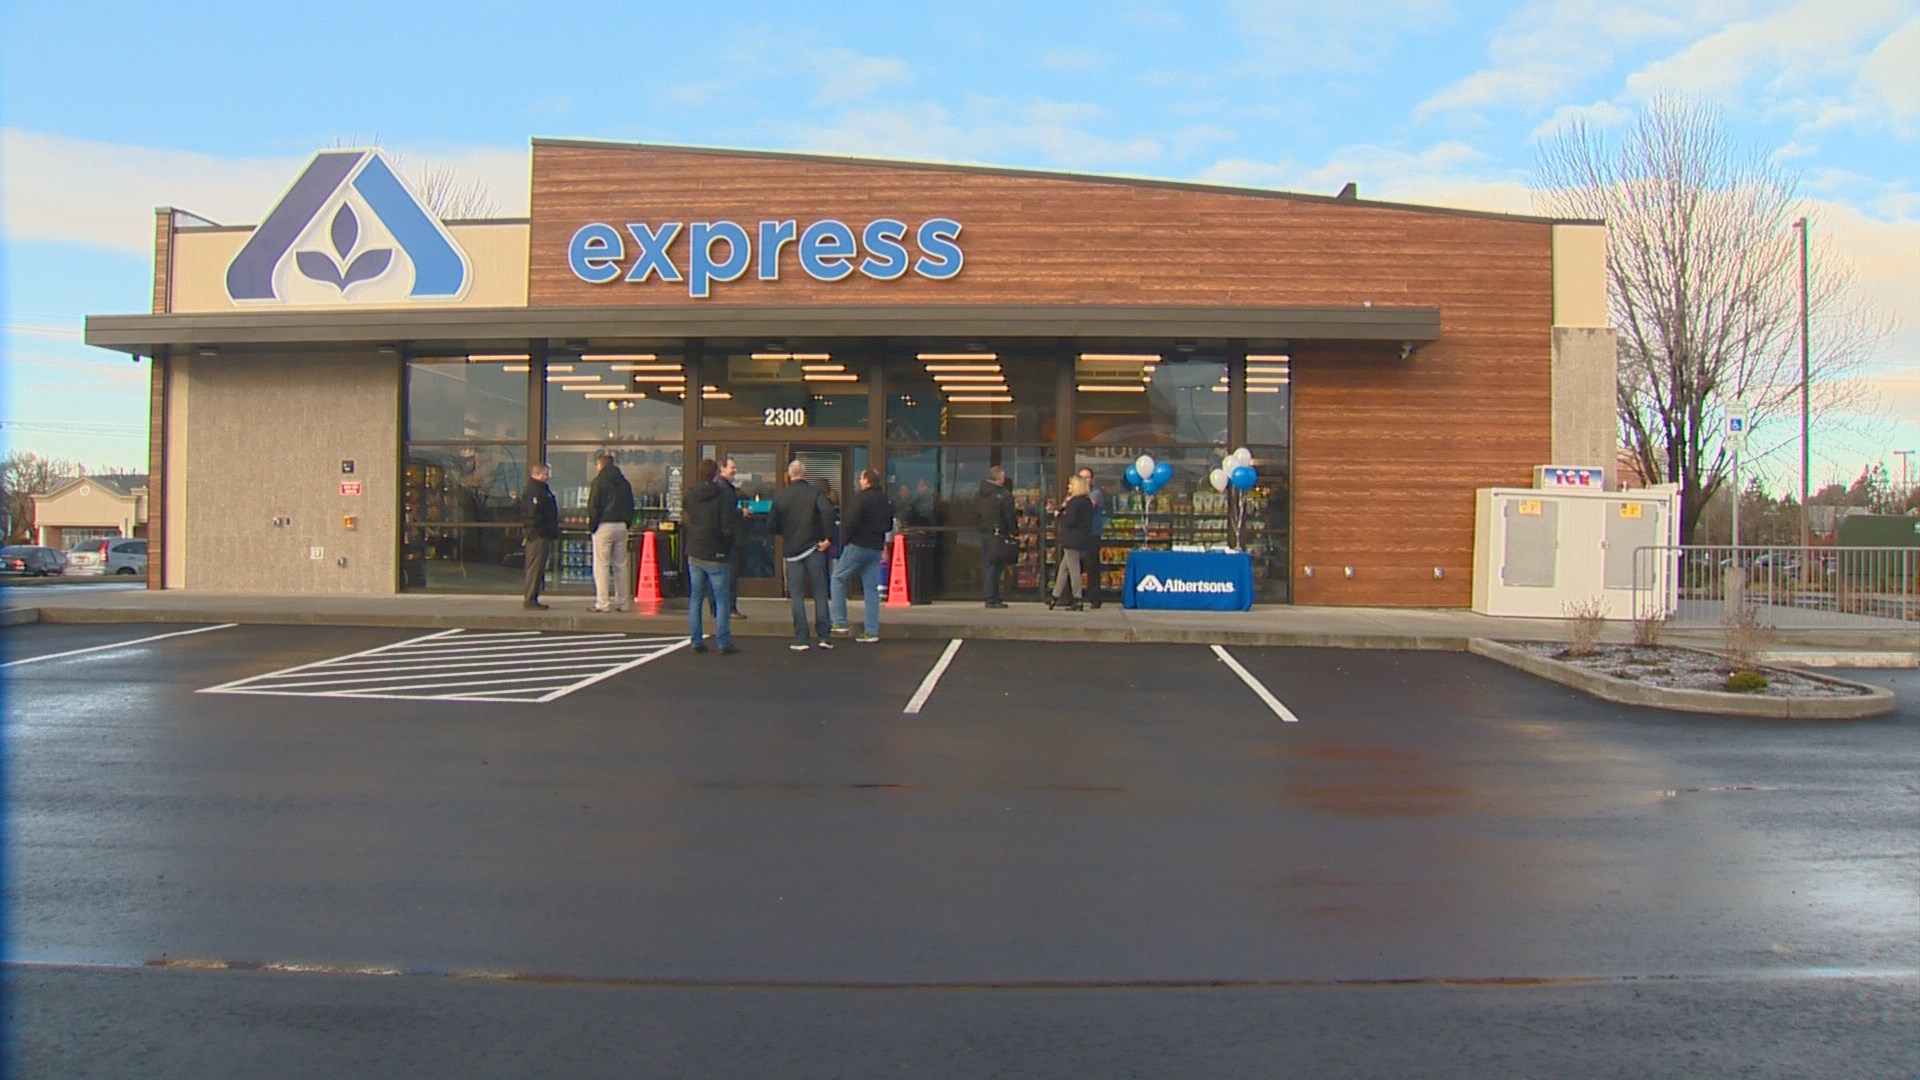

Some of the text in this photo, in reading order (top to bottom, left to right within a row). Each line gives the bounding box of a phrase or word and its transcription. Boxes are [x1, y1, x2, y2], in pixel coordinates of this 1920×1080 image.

[568, 218, 963, 297] express
[765, 408, 805, 426] 2300
[1556, 469, 1591, 487] ICE
[1164, 578, 1235, 593] Albertsons
